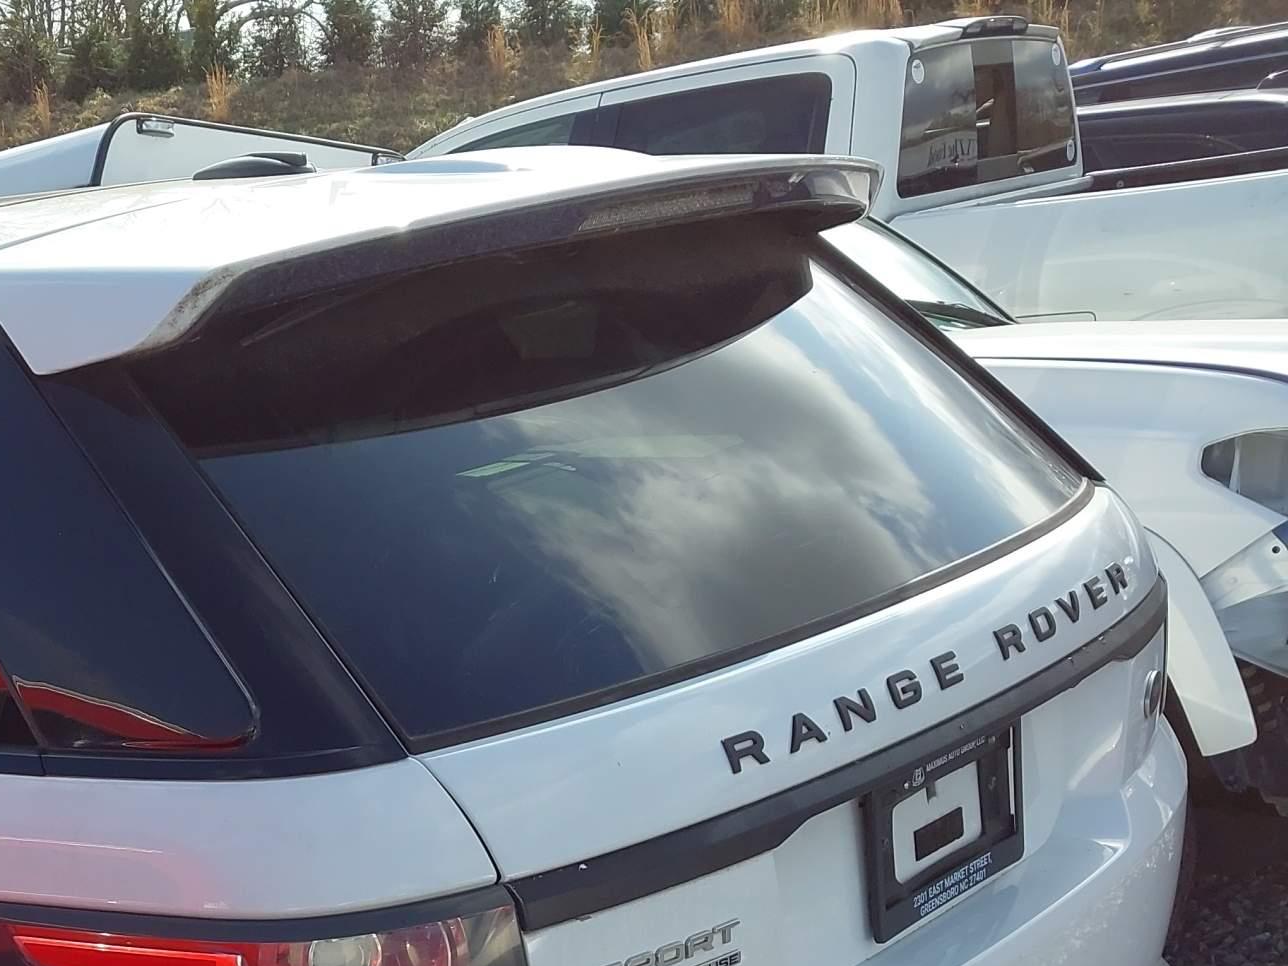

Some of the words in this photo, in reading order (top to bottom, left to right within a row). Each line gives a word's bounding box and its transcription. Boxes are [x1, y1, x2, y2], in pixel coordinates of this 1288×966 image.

[720, 651, 965, 774] RANGE
[992, 561, 1129, 661] ROVER
[926, 754, 948, 772] MAXIMUS
[948, 748, 961, 761] AUTO
[976, 736, 986, 746] LLC
[913, 891, 928, 908] 2301
[928, 879, 945, 898] EAST
[944, 865, 969, 887] MARKET
[920, 885, 959, 916] GREENSBORO
[960, 878, 969, 894] NC
[969, 868, 987, 887] 27401
